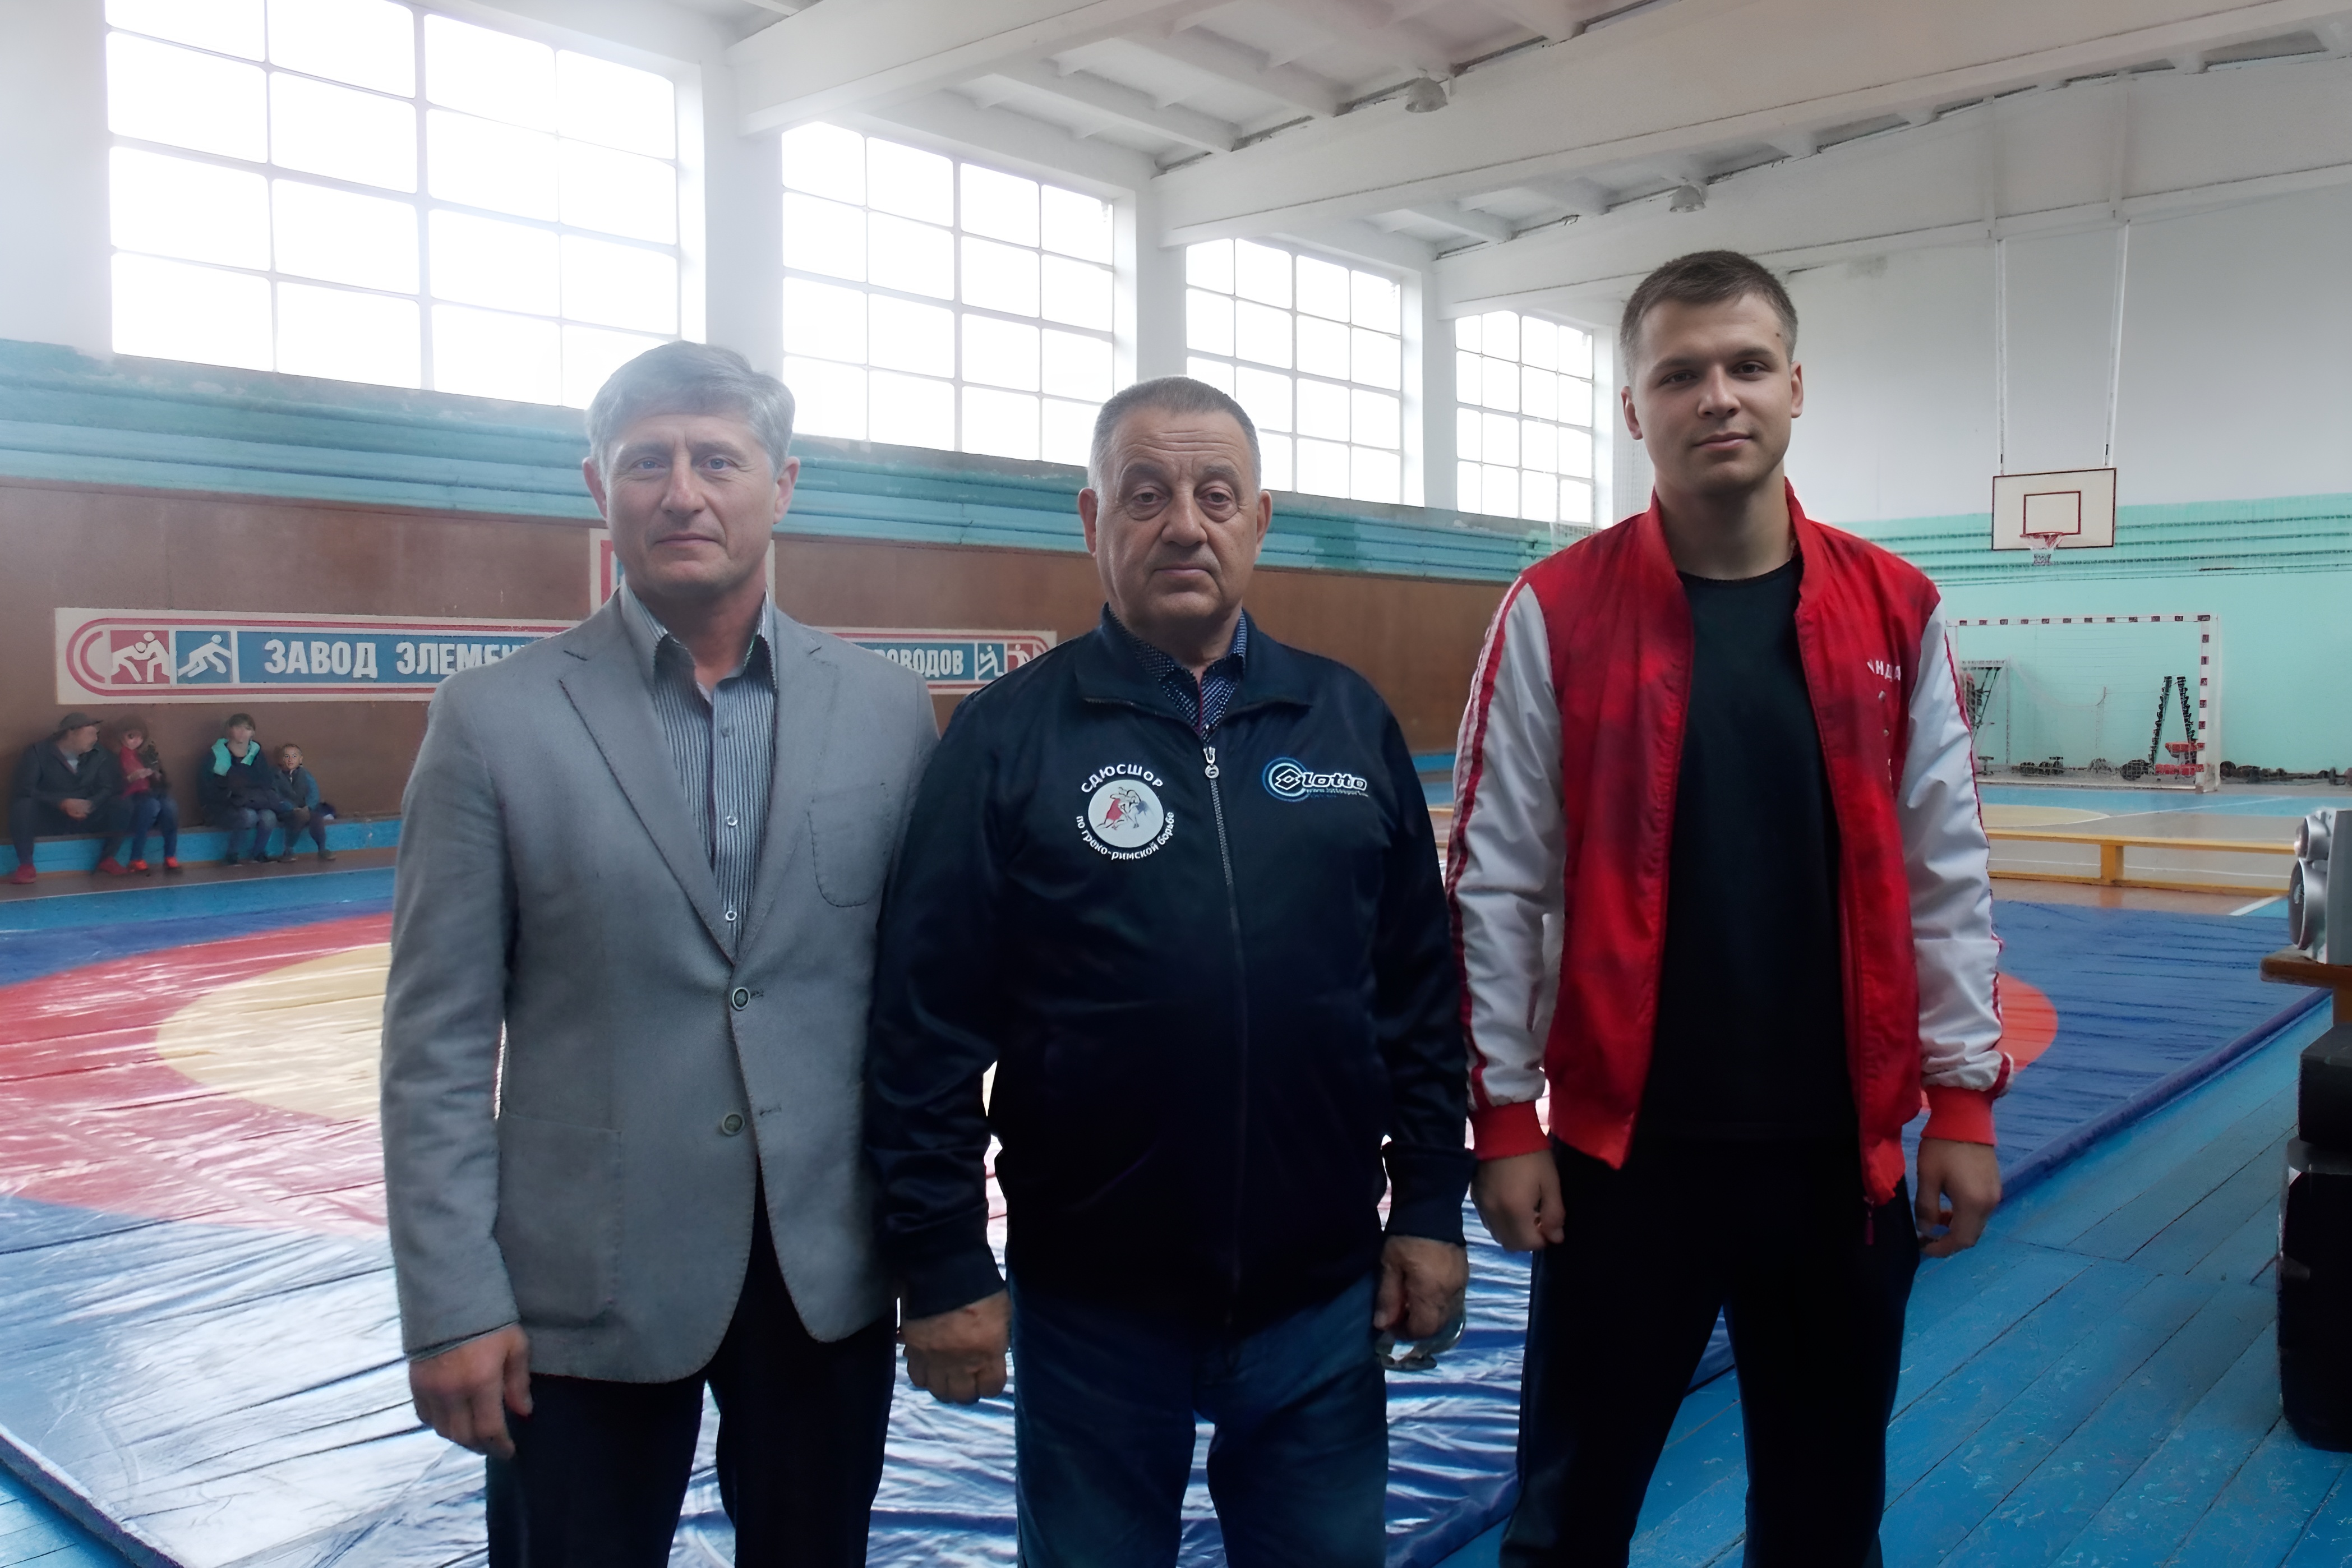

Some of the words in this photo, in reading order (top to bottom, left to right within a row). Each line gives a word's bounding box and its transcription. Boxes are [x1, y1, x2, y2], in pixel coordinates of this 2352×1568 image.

[265, 639, 378, 679] ЗАВОД
[874, 648, 964, 678] ОВОДОВ
[1081, 764, 1163, 793] СДЮСШОР
[1302, 772, 1368, 791] lotto
[1076, 815, 1086, 829] по
[1081, 829, 1159, 860] греко-римской
[1157, 811, 1174, 846] борьбе
